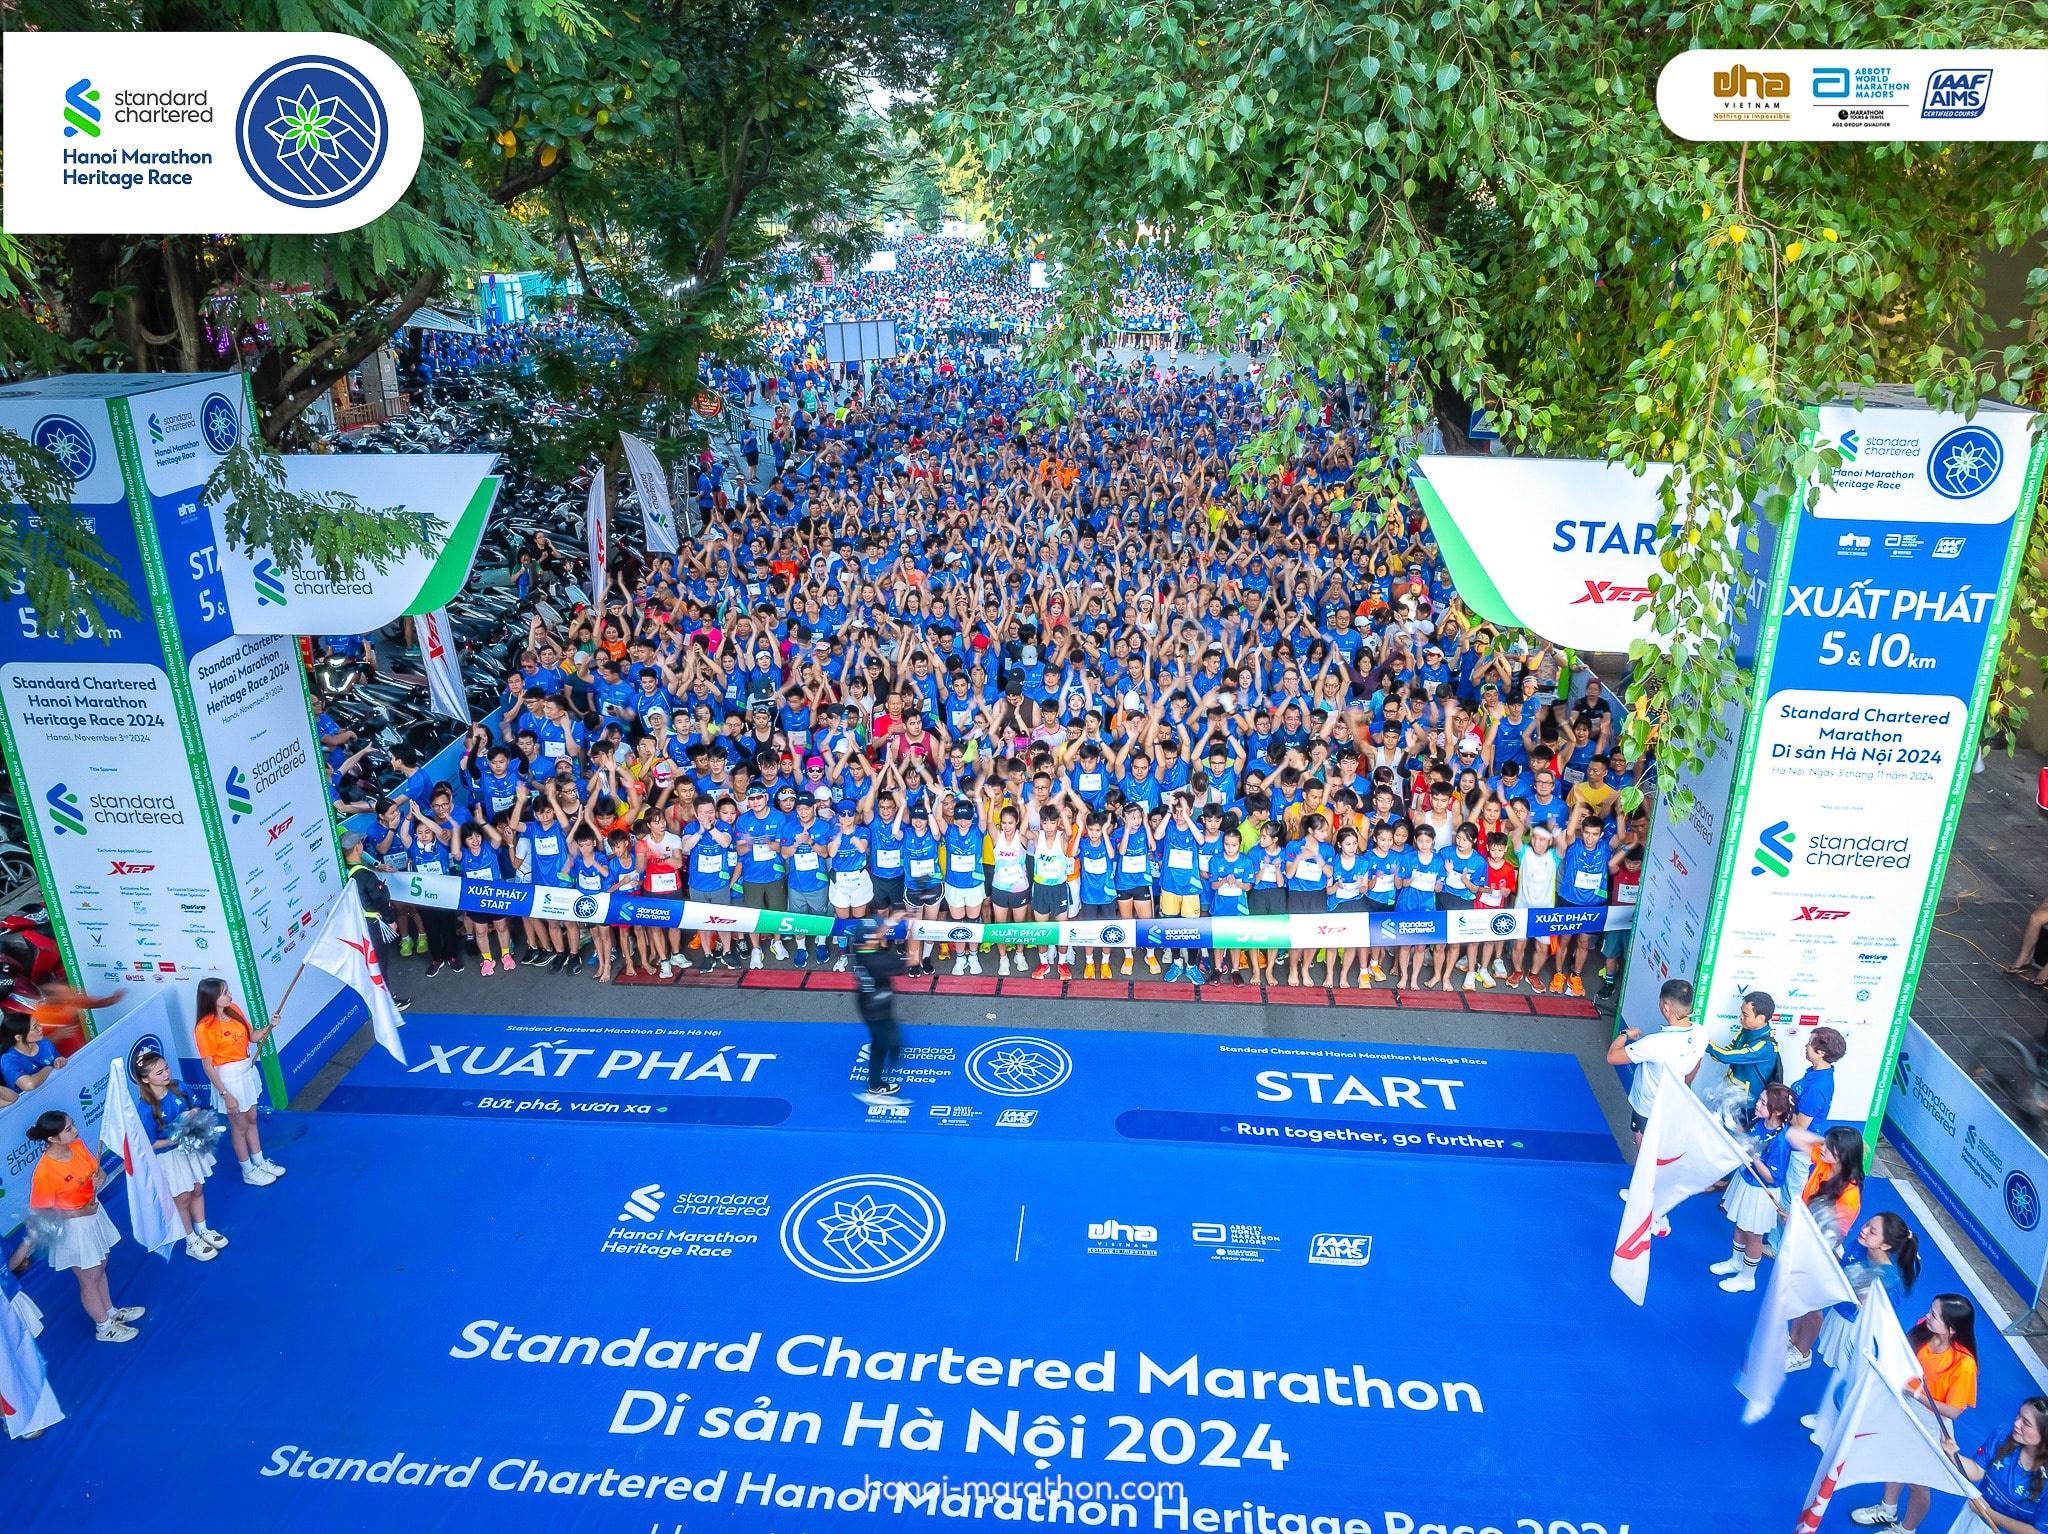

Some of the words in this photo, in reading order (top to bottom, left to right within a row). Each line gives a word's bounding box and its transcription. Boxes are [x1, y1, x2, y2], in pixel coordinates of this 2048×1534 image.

[163, 411, 192, 425] standard
[165, 420, 196, 434] chartered
[154, 446, 173, 458] Hanoi
[172, 440, 199, 454] Marathon
[1865, 436, 1920, 447] standard
[1864, 445, 1920, 457] chartered
[156, 455, 181, 468] Heritage
[181, 451, 195, 462] Race
[1864, 469, 1914, 479] Marathon
[1833, 479, 1875, 490] Heritage
[1876, 480, 1901, 490] Race
[294, 581, 373, 595] chartered
[1569, 580, 1660, 605] XTEP
[199, 589, 215, 622] 5
[217, 601, 226, 616] &
[1783, 578, 1890, 620] XUẤT
[1891, 585, 1996, 624] PHÁT
[1818, 631, 1846, 665] 5
[1846, 650, 1862, 666] &
[198, 650, 241, 680] Standard
[208, 671, 237, 694] Hanoi
[238, 650, 280, 684] Marathon
[13, 676, 80, 690] Standard
[82, 677, 157, 691] Chartered
[206, 686, 247, 716] Heritage
[247, 673, 269, 697] Race
[269, 662, 290, 684] 2024
[28, 695, 73, 708] Hanoi
[75, 696, 147, 709] Marathon
[23, 713, 87, 729] Heritage
[90, 714, 124, 727] Race
[128, 714, 165, 728] 2024
[1780, 704, 1860, 721] Standard
[1864, 708, 1950, 725] Chartered
[1818, 727, 1902, 743] Marathon
[251, 737, 301, 780] standard
[1772, 743, 1792, 758] Di
[1794, 745, 1826, 760] sản
[1831, 746, 1855, 761] Hà
[1861, 747, 1893, 766] Nội
[1896, 748, 1942, 765] 2024
[255, 750, 307, 794] chartered
[90, 794, 175, 810] standard
[94, 809, 184, 825] chartered
[266, 815, 294, 848] XTEP
[1809, 834, 1909, 852] standard
[1806, 851, 1911, 869] chartered
[107, 861, 155, 876] XTEP
[410, 877, 422, 897] 5
[424, 891, 438, 900] km
[467, 884, 495, 898] XUẤT
[497, 887, 528, 902] PHÁT/
[480, 898, 511, 911] START
[636, 906, 670, 917] standard
[635, 912, 671, 922] chartered
[1535, 912, 1563, 924] XUẤT
[1564, 911, 1600, 924] PHÁT/
[1790, 906, 1850, 921] XTEP
[778, 917, 793, 932] 5
[1164, 928, 1199, 936] standard
[1398, 920, 1434, 930] standard
[1398, 925, 1436, 934] chartered
[1549, 922, 1583, 932] START
[990, 929, 1016, 938] XUẤT
[1164, 933, 1200, 941] chartered
[506, 1024, 552, 1033] Standard
[553, 1025, 602, 1034] Chartered
[604, 1027, 653, 1035] Marathon
[407, 1039, 596, 1077] XUẤT
[597, 1046, 778, 1082] PHÁT
[1219, 1045, 1268, 1055] Standard
[1270, 1048, 1323, 1057] Chartered
[1325, 1050, 1356, 1059] Hanoi
[1358, 1052, 1410, 1062] Marathon
[1412, 1054, 1459, 1065] Heritage
[1461, 1057, 1487, 1065] Race
[906, 1075, 937, 1083] Race
[1255, 1071, 1464, 1111] START
[477, 1097, 513, 1110] Bứt
[515, 1098, 563, 1114] phá,
[569, 1100, 619, 1113] vươn
[623, 1103, 651, 1114] xa
[1914, 1075, 1956, 1125] standard
[1912, 1087, 1956, 1138] chartered
[1237, 1122, 1280, 1139] Run
[1284, 1125, 1388, 1146] together,
[1392, 1130, 1423, 1147] go
[1426, 1132, 1505, 1149] further
[675, 1192, 769, 1206] standard
[672, 1203, 770, 1217] chartered
[608, 1227, 665, 1242] Hanoi
[666, 1230, 757, 1243] Marathon
[1230, 1234, 1280, 1242] MARATHON
[1316, 1236, 1367, 1249] IAAF
[600, 1241, 684, 1259] Heritage
[686, 1244, 732, 1257] Race
[1316, 1247, 1363, 1258] AIMS
[449, 1319, 763, 1373] Standard
[776, 1333, 1115, 1393] Chartered
[1138, 1350, 1484, 1415] Marathon
[698, 1395, 823, 1445] sản
[842, 1402, 945, 1453] Hà
[965, 1409, 1086, 1471] Nội
[1104, 1414, 1290, 1471] 2024
[259, 1445, 483, 1488] Standard
[487, 1458, 728, 1503] Chartered
[735, 1471, 885, 1514] Hanoi
[893, 1483, 1138, 1529] Marathon
